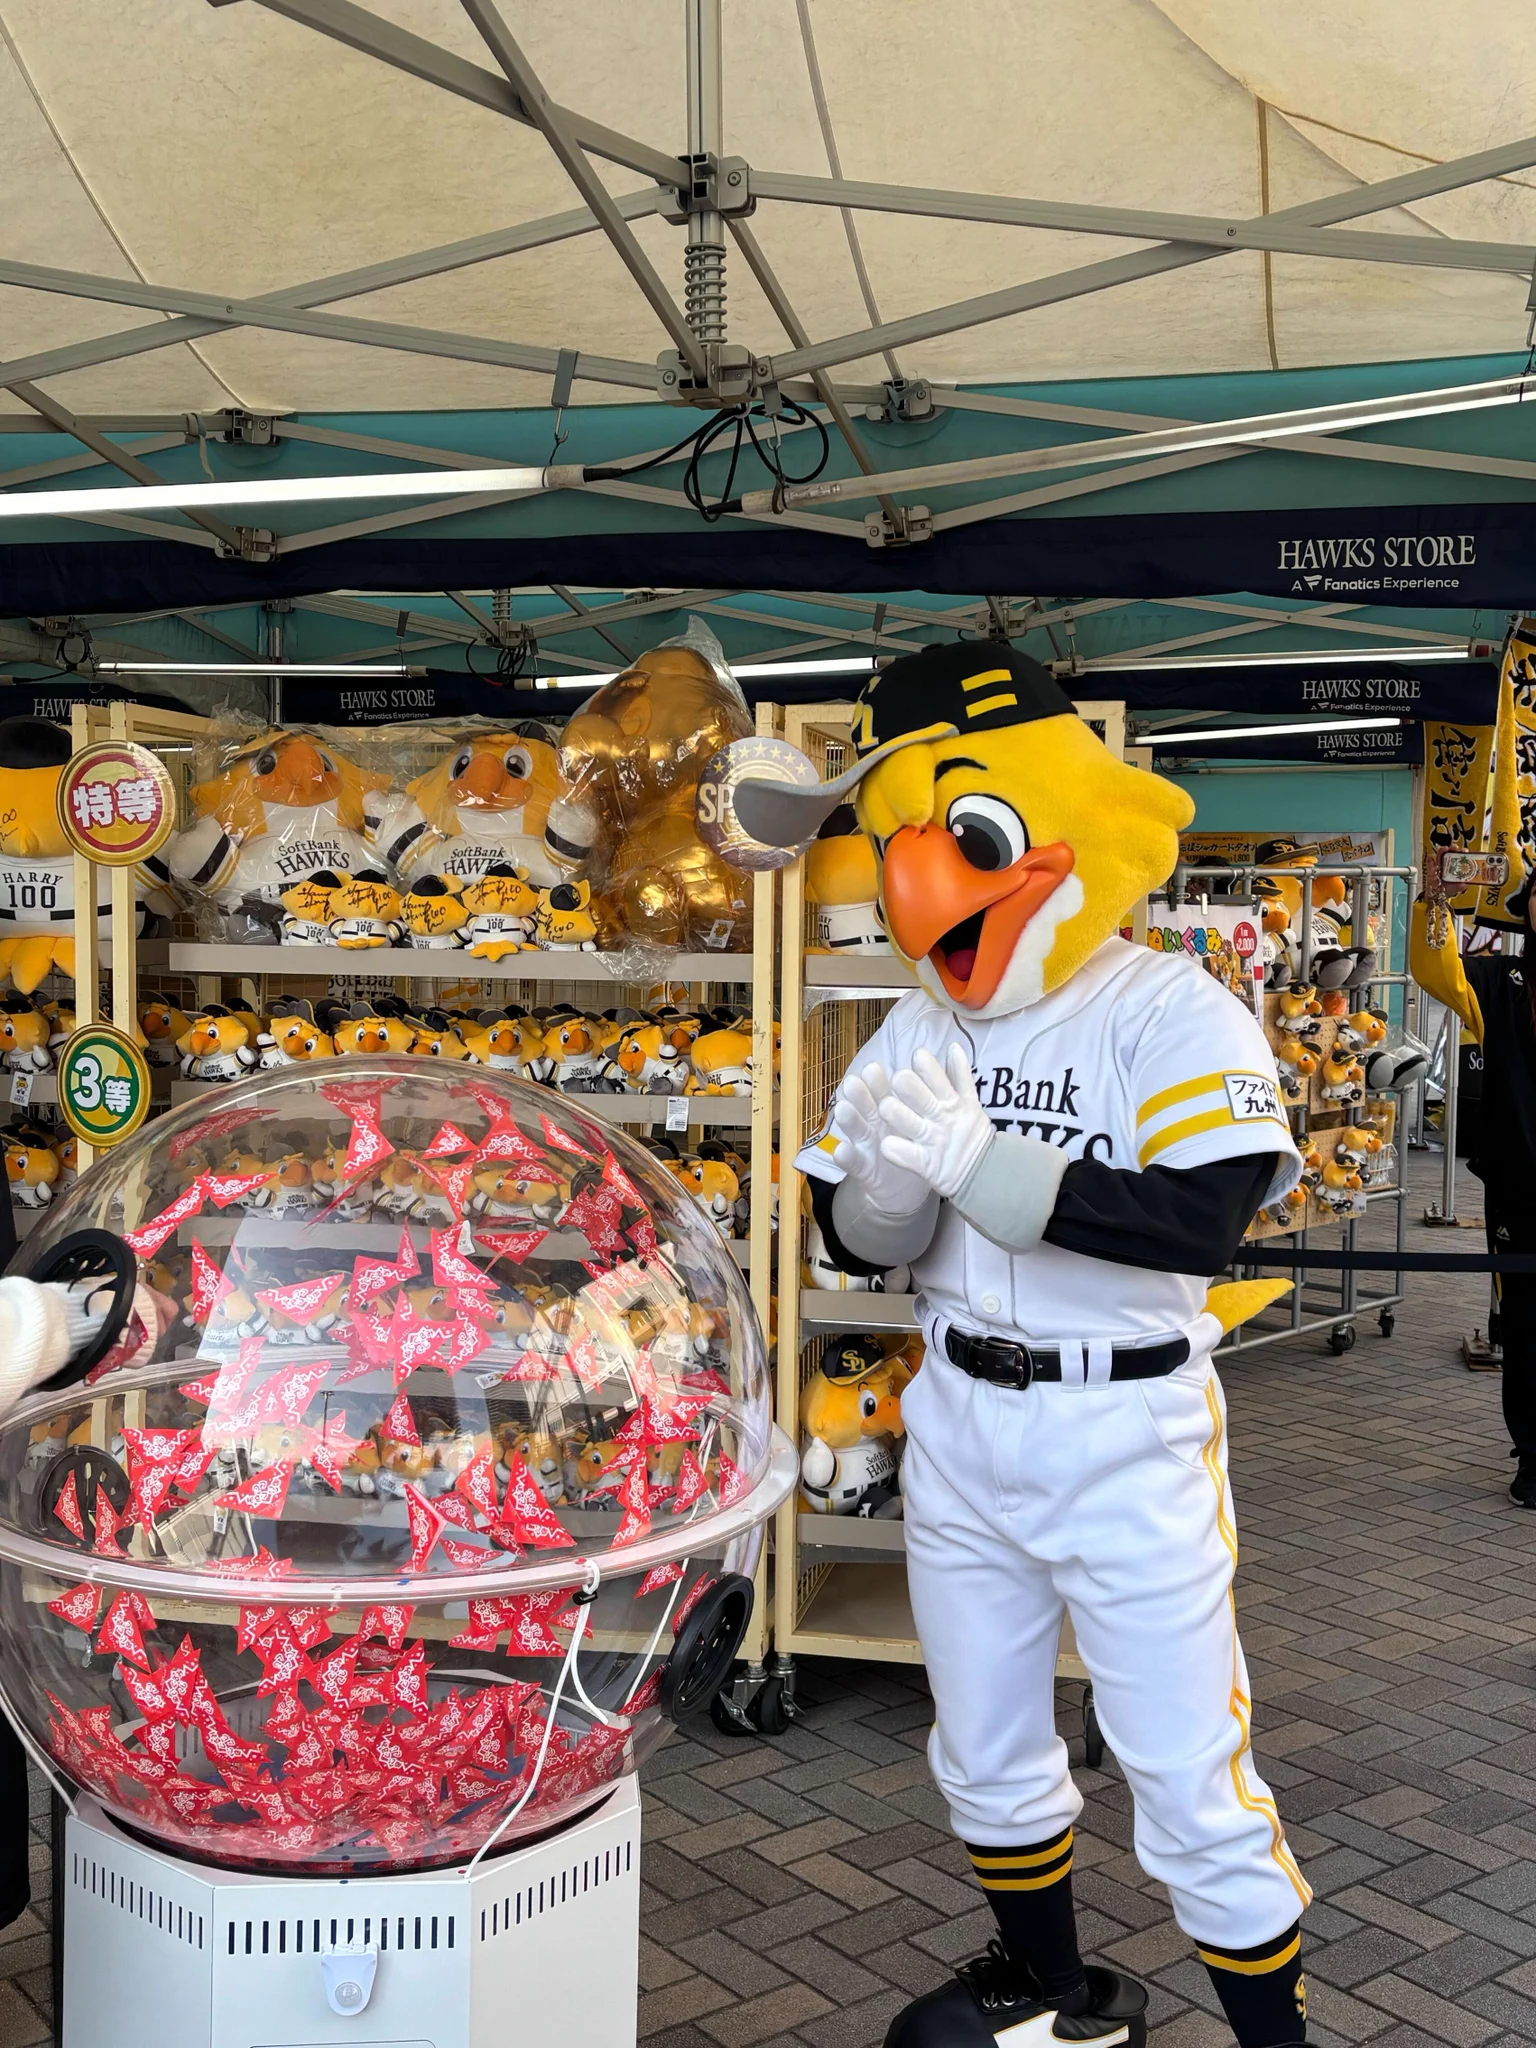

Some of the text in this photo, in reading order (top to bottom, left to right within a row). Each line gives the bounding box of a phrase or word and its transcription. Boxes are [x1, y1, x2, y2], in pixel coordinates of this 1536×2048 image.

[1277, 535, 1477, 570] HAWKS STORE
[1291, 577, 1460, 592] A Fanatics Experience
[340, 689, 436, 709] HAWKS STORE
[1301, 679, 1422, 700] HAWKS STORE
[1364, 703, 1411, 712] Experience
[1317, 732, 1403, 749] HAWKS STORE
[73, 779, 157, 828] 特等
[278, 839, 341, 857] SoftBank
[450, 846, 506, 859] SoftBank
[274, 850, 350, 878] HAWKS
[2, 871, 64, 887] HARRY
[9, 884, 56, 909] 100
[356, 923, 373, 933] 100
[72, 1056, 132, 1114] 3等
[971, 1067, 1081, 1117] tBank
[1244, 1096, 1279, 1117] 九州
